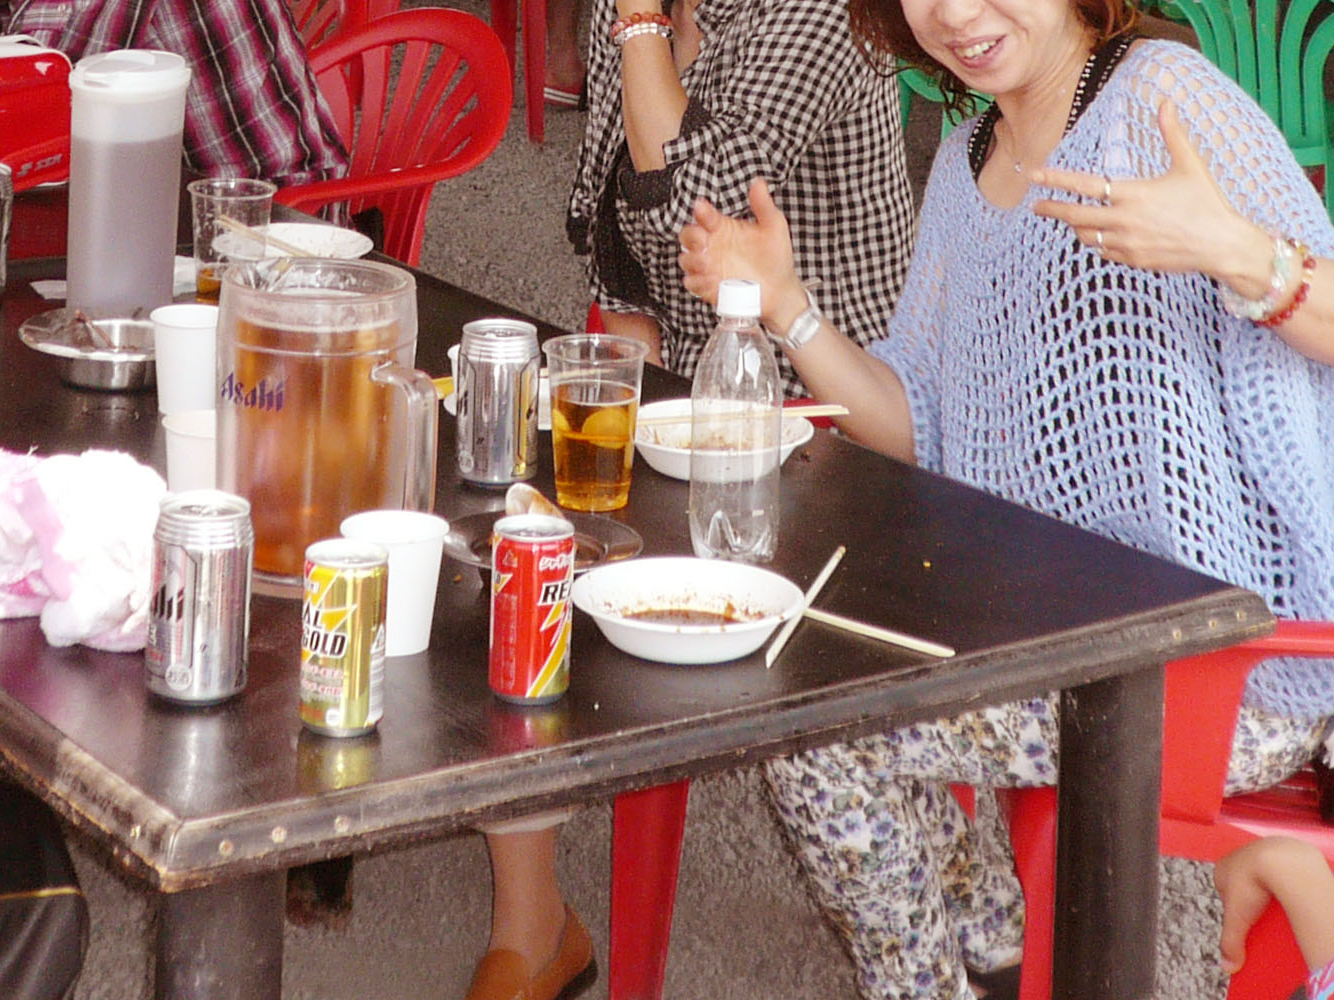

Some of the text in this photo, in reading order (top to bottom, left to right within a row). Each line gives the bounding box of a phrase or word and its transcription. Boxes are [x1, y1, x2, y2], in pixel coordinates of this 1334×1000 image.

[221, 371, 284, 413] Asahi
[541, 581, 571, 605] RE
[303, 601, 323, 630] AL
[301, 629, 347, 656] GOLD
